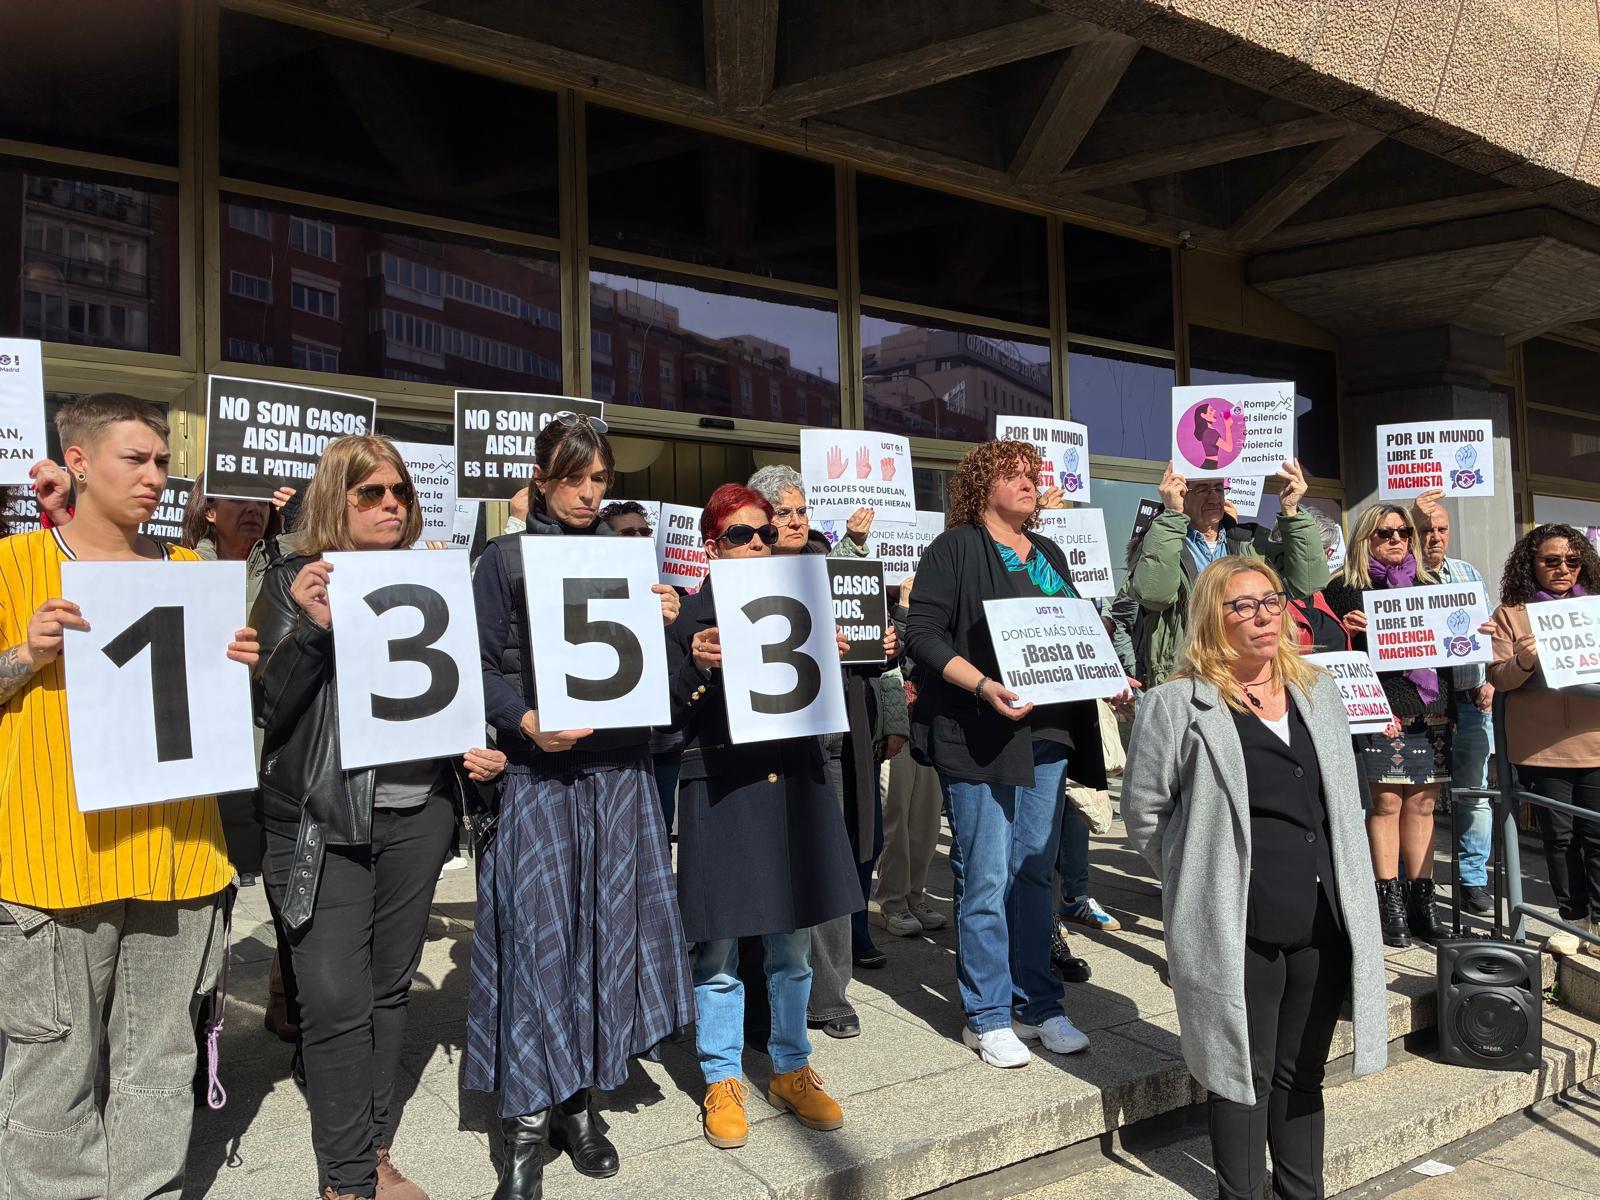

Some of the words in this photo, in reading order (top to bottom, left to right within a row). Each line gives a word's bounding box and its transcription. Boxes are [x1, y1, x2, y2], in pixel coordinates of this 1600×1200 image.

[1243, 400, 1276, 411] Rompe
[219, 396, 250, 421] NO
[257, 401, 300, 427] SON
[306, 408, 367, 436] CASOS
[464, 409, 490, 430] NO
[496, 410, 534, 432] SON
[1243, 413, 1252, 422] el
[1253, 411, 1288, 422] silencio
[0, 428, 23, 441] AN,
[1005, 426, 1029, 441] POR
[1033, 427, 1048, 442] UN
[1051, 429, 1084, 447] MUNDO
[1243, 427, 1272, 436] contra
[1274, 426, 1283, 435] la
[1387, 432, 1413, 446] POR
[1417, 431, 1435, 444] UN
[1439, 429, 1485, 443] MUNDO
[485, 435, 536, 457] AISLA
[881, 442, 894, 450] UGT
[1242, 440, 1283, 449] violencia
[0, 448, 34, 459] RAN
[1241, 453, 1288, 463] machista.
[1387, 449, 1416, 462] LIBRE
[1420, 448, 1434, 460] DE
[216, 454, 236, 472] ES
[241, 456, 258, 474] EL
[263, 458, 319, 480] PATRIA
[404, 461, 436, 472] ompe
[464, 461, 481, 477] ES
[485, 462, 499, 478] EL
[1387, 461, 1443, 475] VIOLENCIA
[1387, 475, 1444, 489] MACHISTA
[434, 490, 443, 500] la
[811, 485, 822, 493] NI
[823, 485, 857, 493] GOLPES
[858, 486, 875, 494] QUE
[876, 486, 907, 497] DUELAN,
[420, 504, 443, 513] ncia
[809, 498, 819, 506] NI
[820, 497, 866, 506] PALABRAS
[868, 498, 884, 507] QUE
[884, 500, 911, 509] HIERAN
[1141, 505, 1153, 516] NO
[150, 505, 185, 522] SLAD
[424, 518, 447, 528] ista.
[668, 514, 694, 530] POR
[147, 523, 184, 538] PATRIA
[896, 530, 914, 540] MÁS
[915, 532, 935, 541] DUELE
[452, 532, 471, 546] ria!
[665, 532, 695, 547] LIBRE
[697, 539, 705, 549] D
[876, 542, 914, 558] ¡Basta
[1069, 548, 1086, 565] de
[662, 561, 709, 578] MACHIST
[1071, 568, 1109, 583] icaria!
[833, 575, 880, 595] CASOS
[833, 599, 864, 621] DOS,
[1035, 606, 1051, 615] UGT
[1374, 598, 1401, 614] POR
[1406, 597, 1425, 611] UN
[1428, 591, 1477, 609] MUNDO
[1376, 617, 1406, 631] LIBRE
[1410, 615, 1425, 628] DE
[1537, 613, 1565, 631] NO
[562, 577, 644, 701] 5
[839, 624, 881, 641] RCADO
[1001, 625, 1042, 641] DONDE
[1044, 623, 1067, 637] MÁS
[1377, 629, 1435, 646] VIOLENCIA
[362, 583, 460, 722] 3
[740, 595, 822, 714] 3
[1021, 643, 1075, 668] ¡Basta
[1076, 641, 1096, 660] de
[1379, 644, 1437, 660] MACHISTA
[1551, 655, 1575, 670] AS
[1007, 665, 1074, 688] Violencia
[1074, 662, 1122, 680] Vicaria!
[101, 605, 193, 763] 1
[1351, 684, 1384, 699] FALTAN
